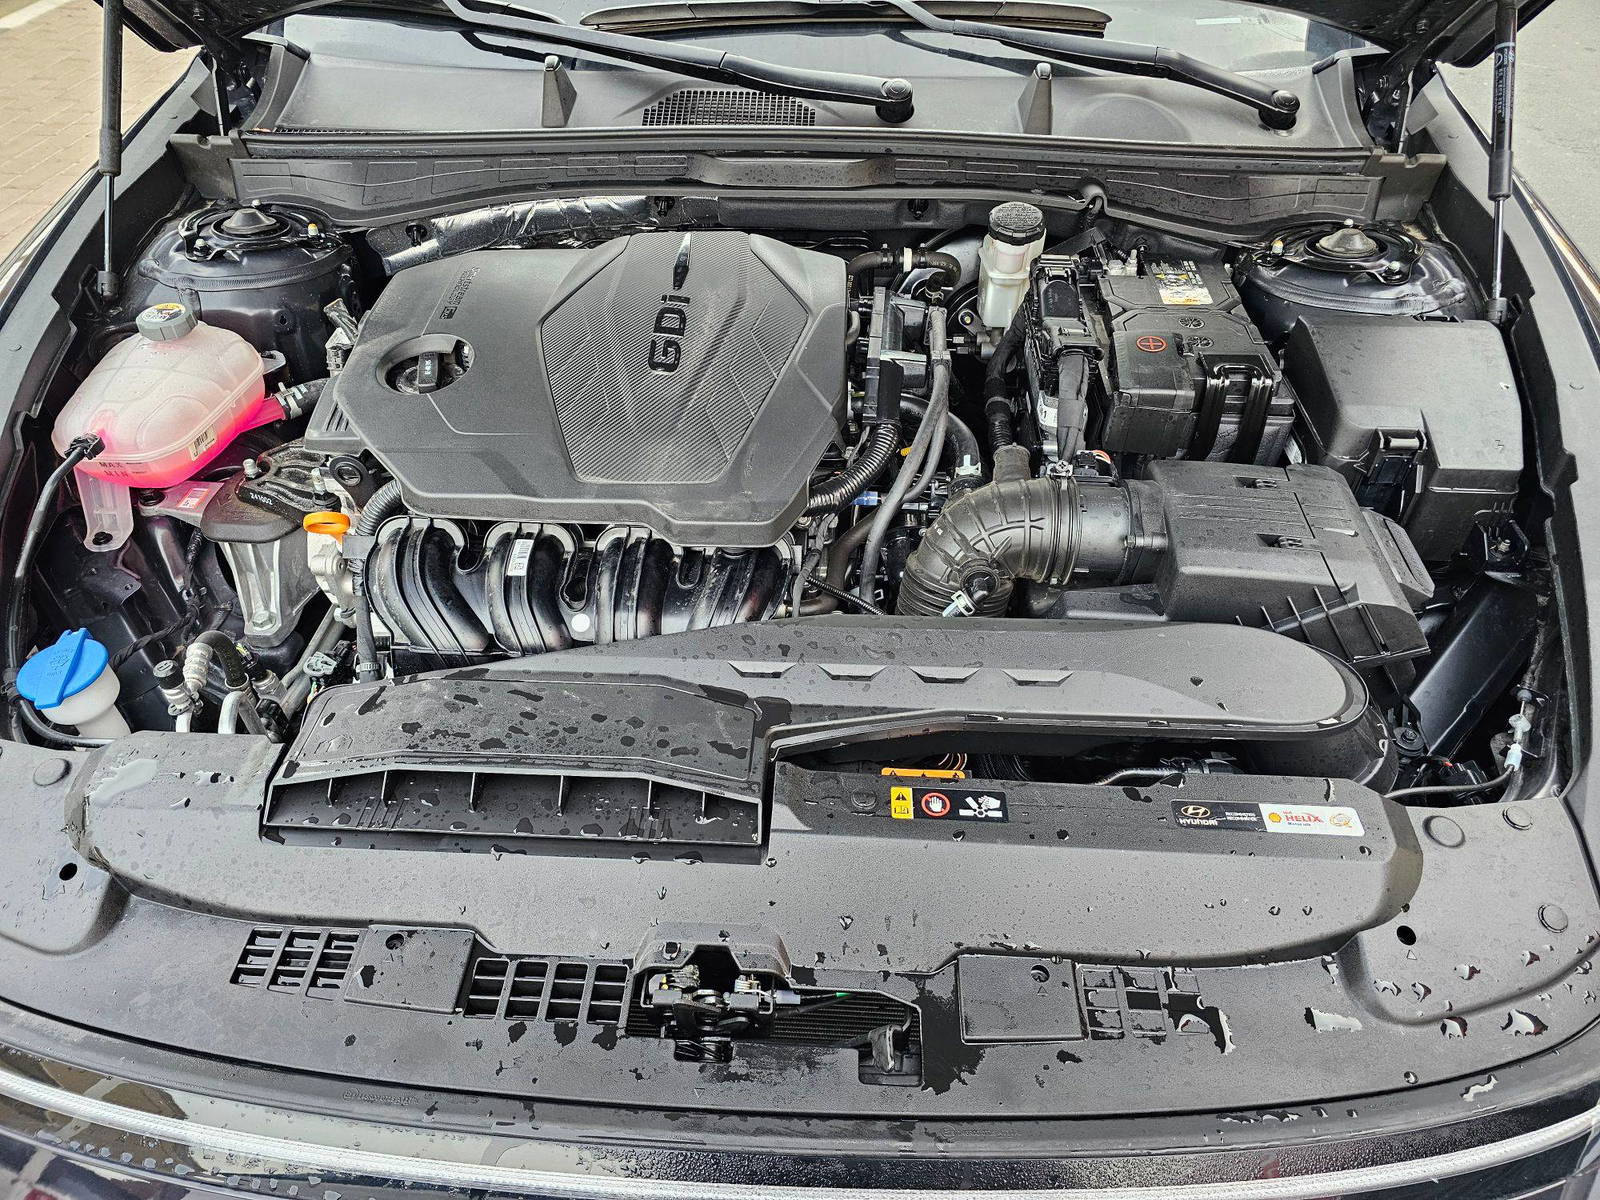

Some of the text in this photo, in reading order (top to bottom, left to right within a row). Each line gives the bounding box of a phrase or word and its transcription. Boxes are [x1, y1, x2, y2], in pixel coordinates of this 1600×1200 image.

[648, 294, 690, 372] GDi
[1178, 818, 1218, 826] HYUNDAI
[1285, 815, 1321, 823] HELIX
